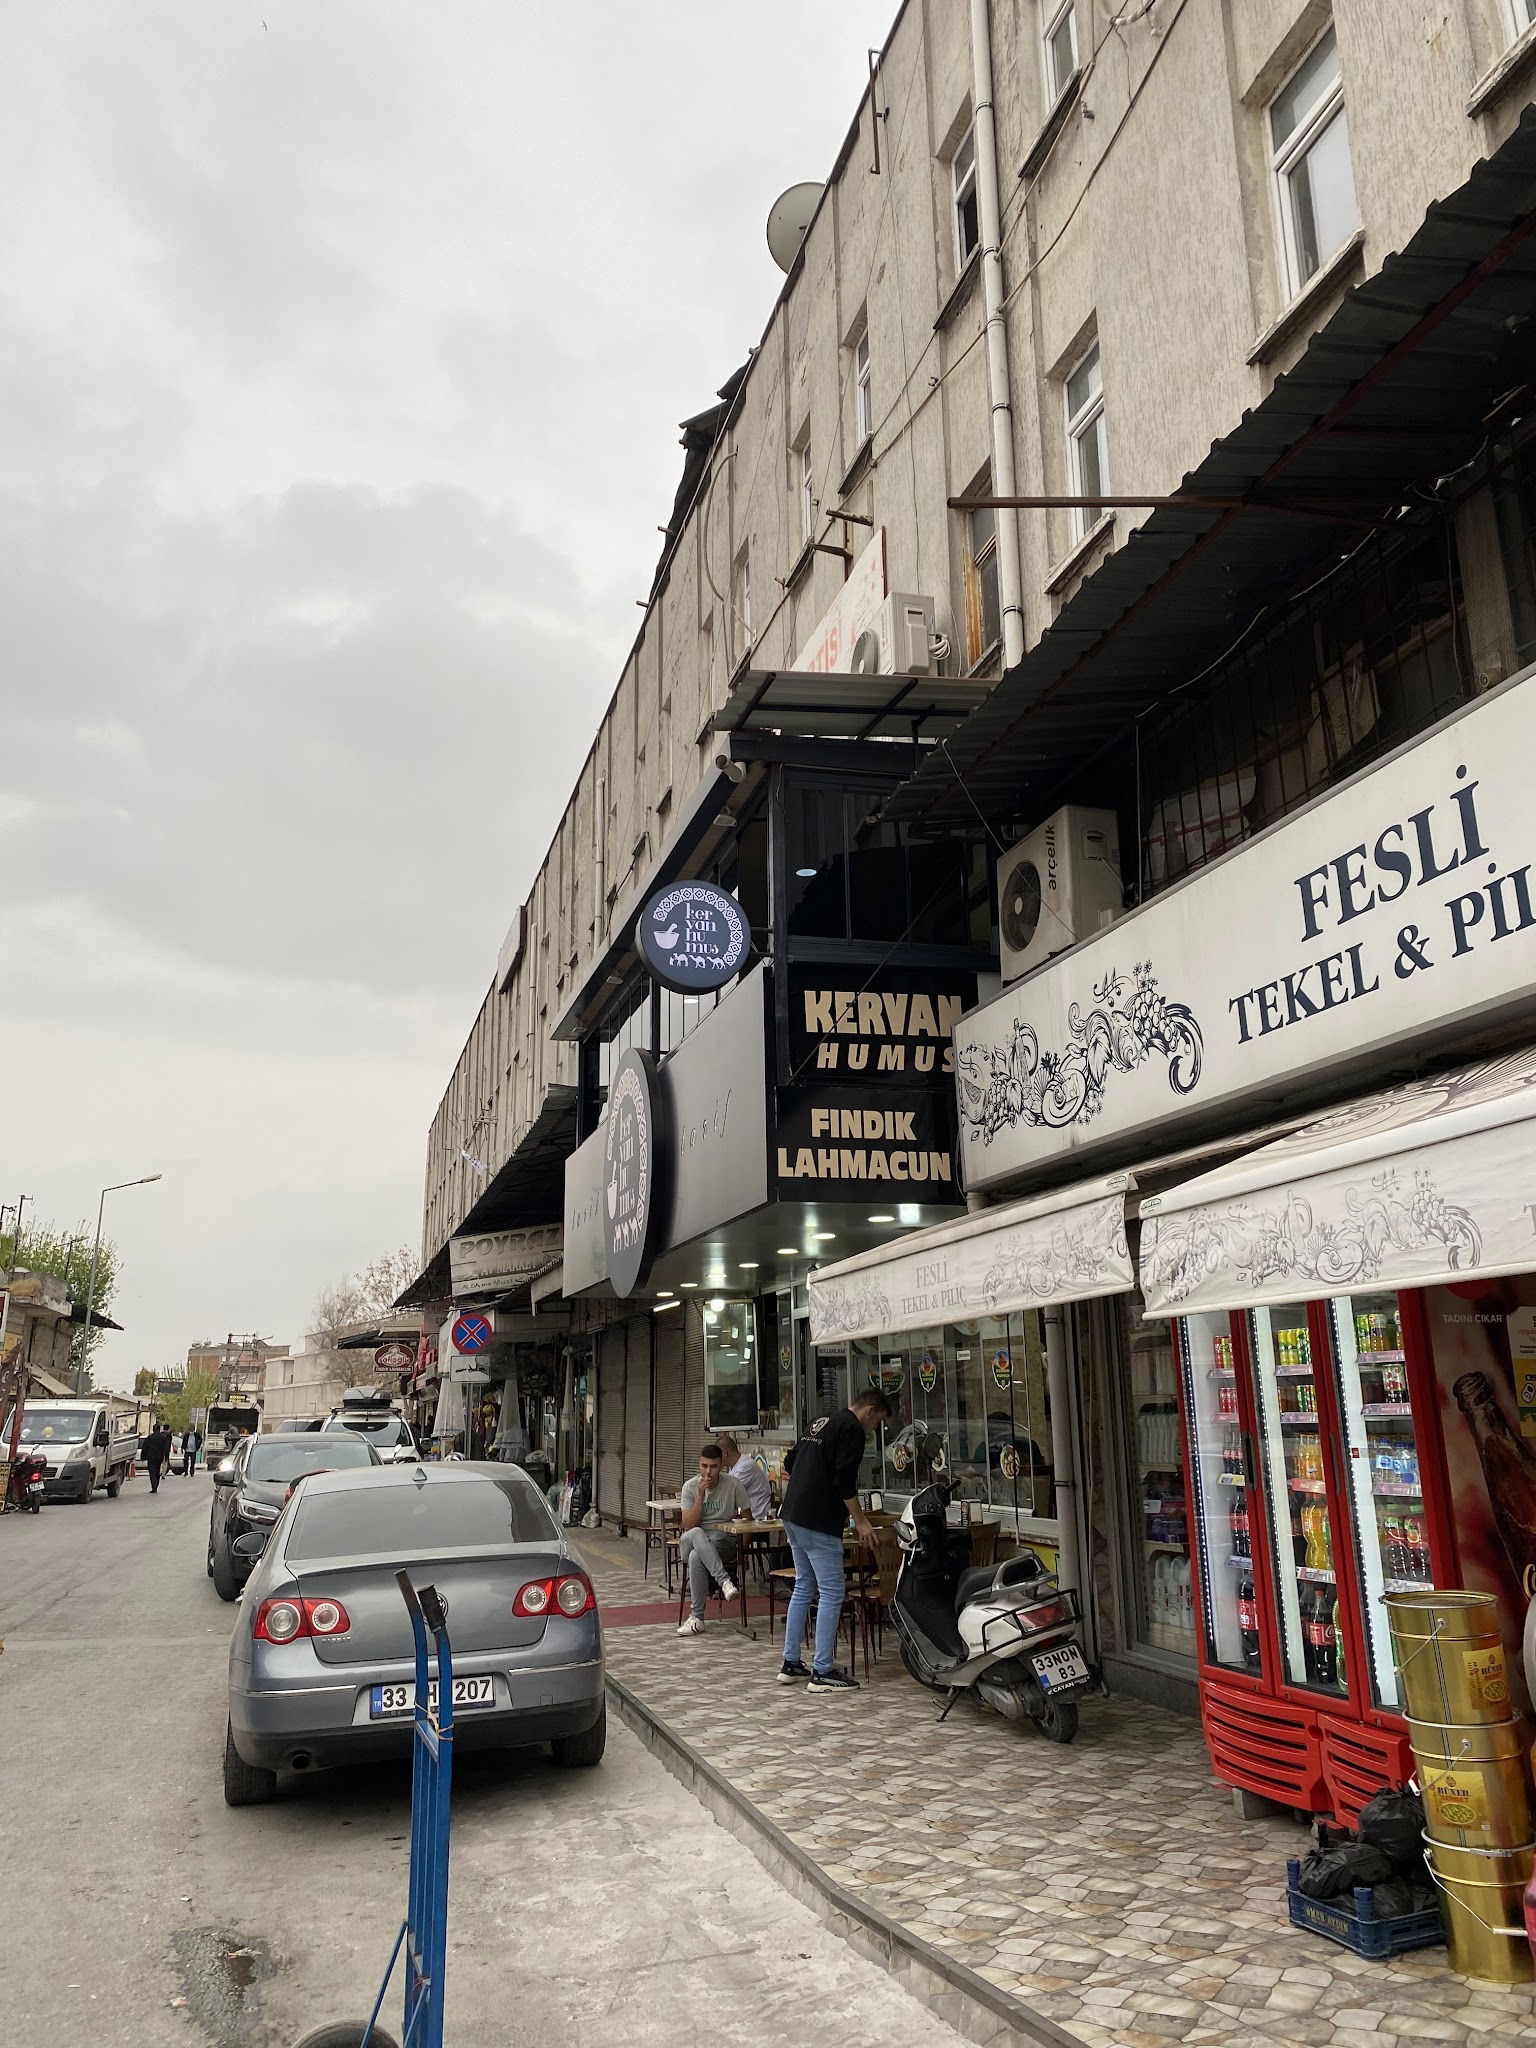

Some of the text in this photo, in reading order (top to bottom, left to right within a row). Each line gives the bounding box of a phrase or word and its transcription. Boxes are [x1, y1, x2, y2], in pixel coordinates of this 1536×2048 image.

[1045, 824, 1058, 891] arçelik
[1293, 764, 1490, 942] FESLİ
[685, 902, 713, 921] ker
[685, 919, 718, 932] van
[684, 927, 706, 942] hu
[684, 941, 720, 954] mus
[1228, 942, 1380, 1045] TEKEL
[1393, 924, 1434, 979] &
[803, 990, 963, 1037] KERVAN
[816, 1042, 956, 1073] HUMUS
[810, 1108, 917, 1141] FINDIK
[777, 1147, 952, 1182] LAHMACUN
[460, 1227, 562, 1259] POYRAZ
[915, 1255, 950, 1289] FESLİ
[901, 1282, 967, 1315] TEKEL & PİLİÇ
[1035, 1647, 1079, 1671] 33NON
[1058, 1664, 1076, 1680] 83
[383, 1686, 407, 1709] 33
[455, 1679, 491, 1701] 207
